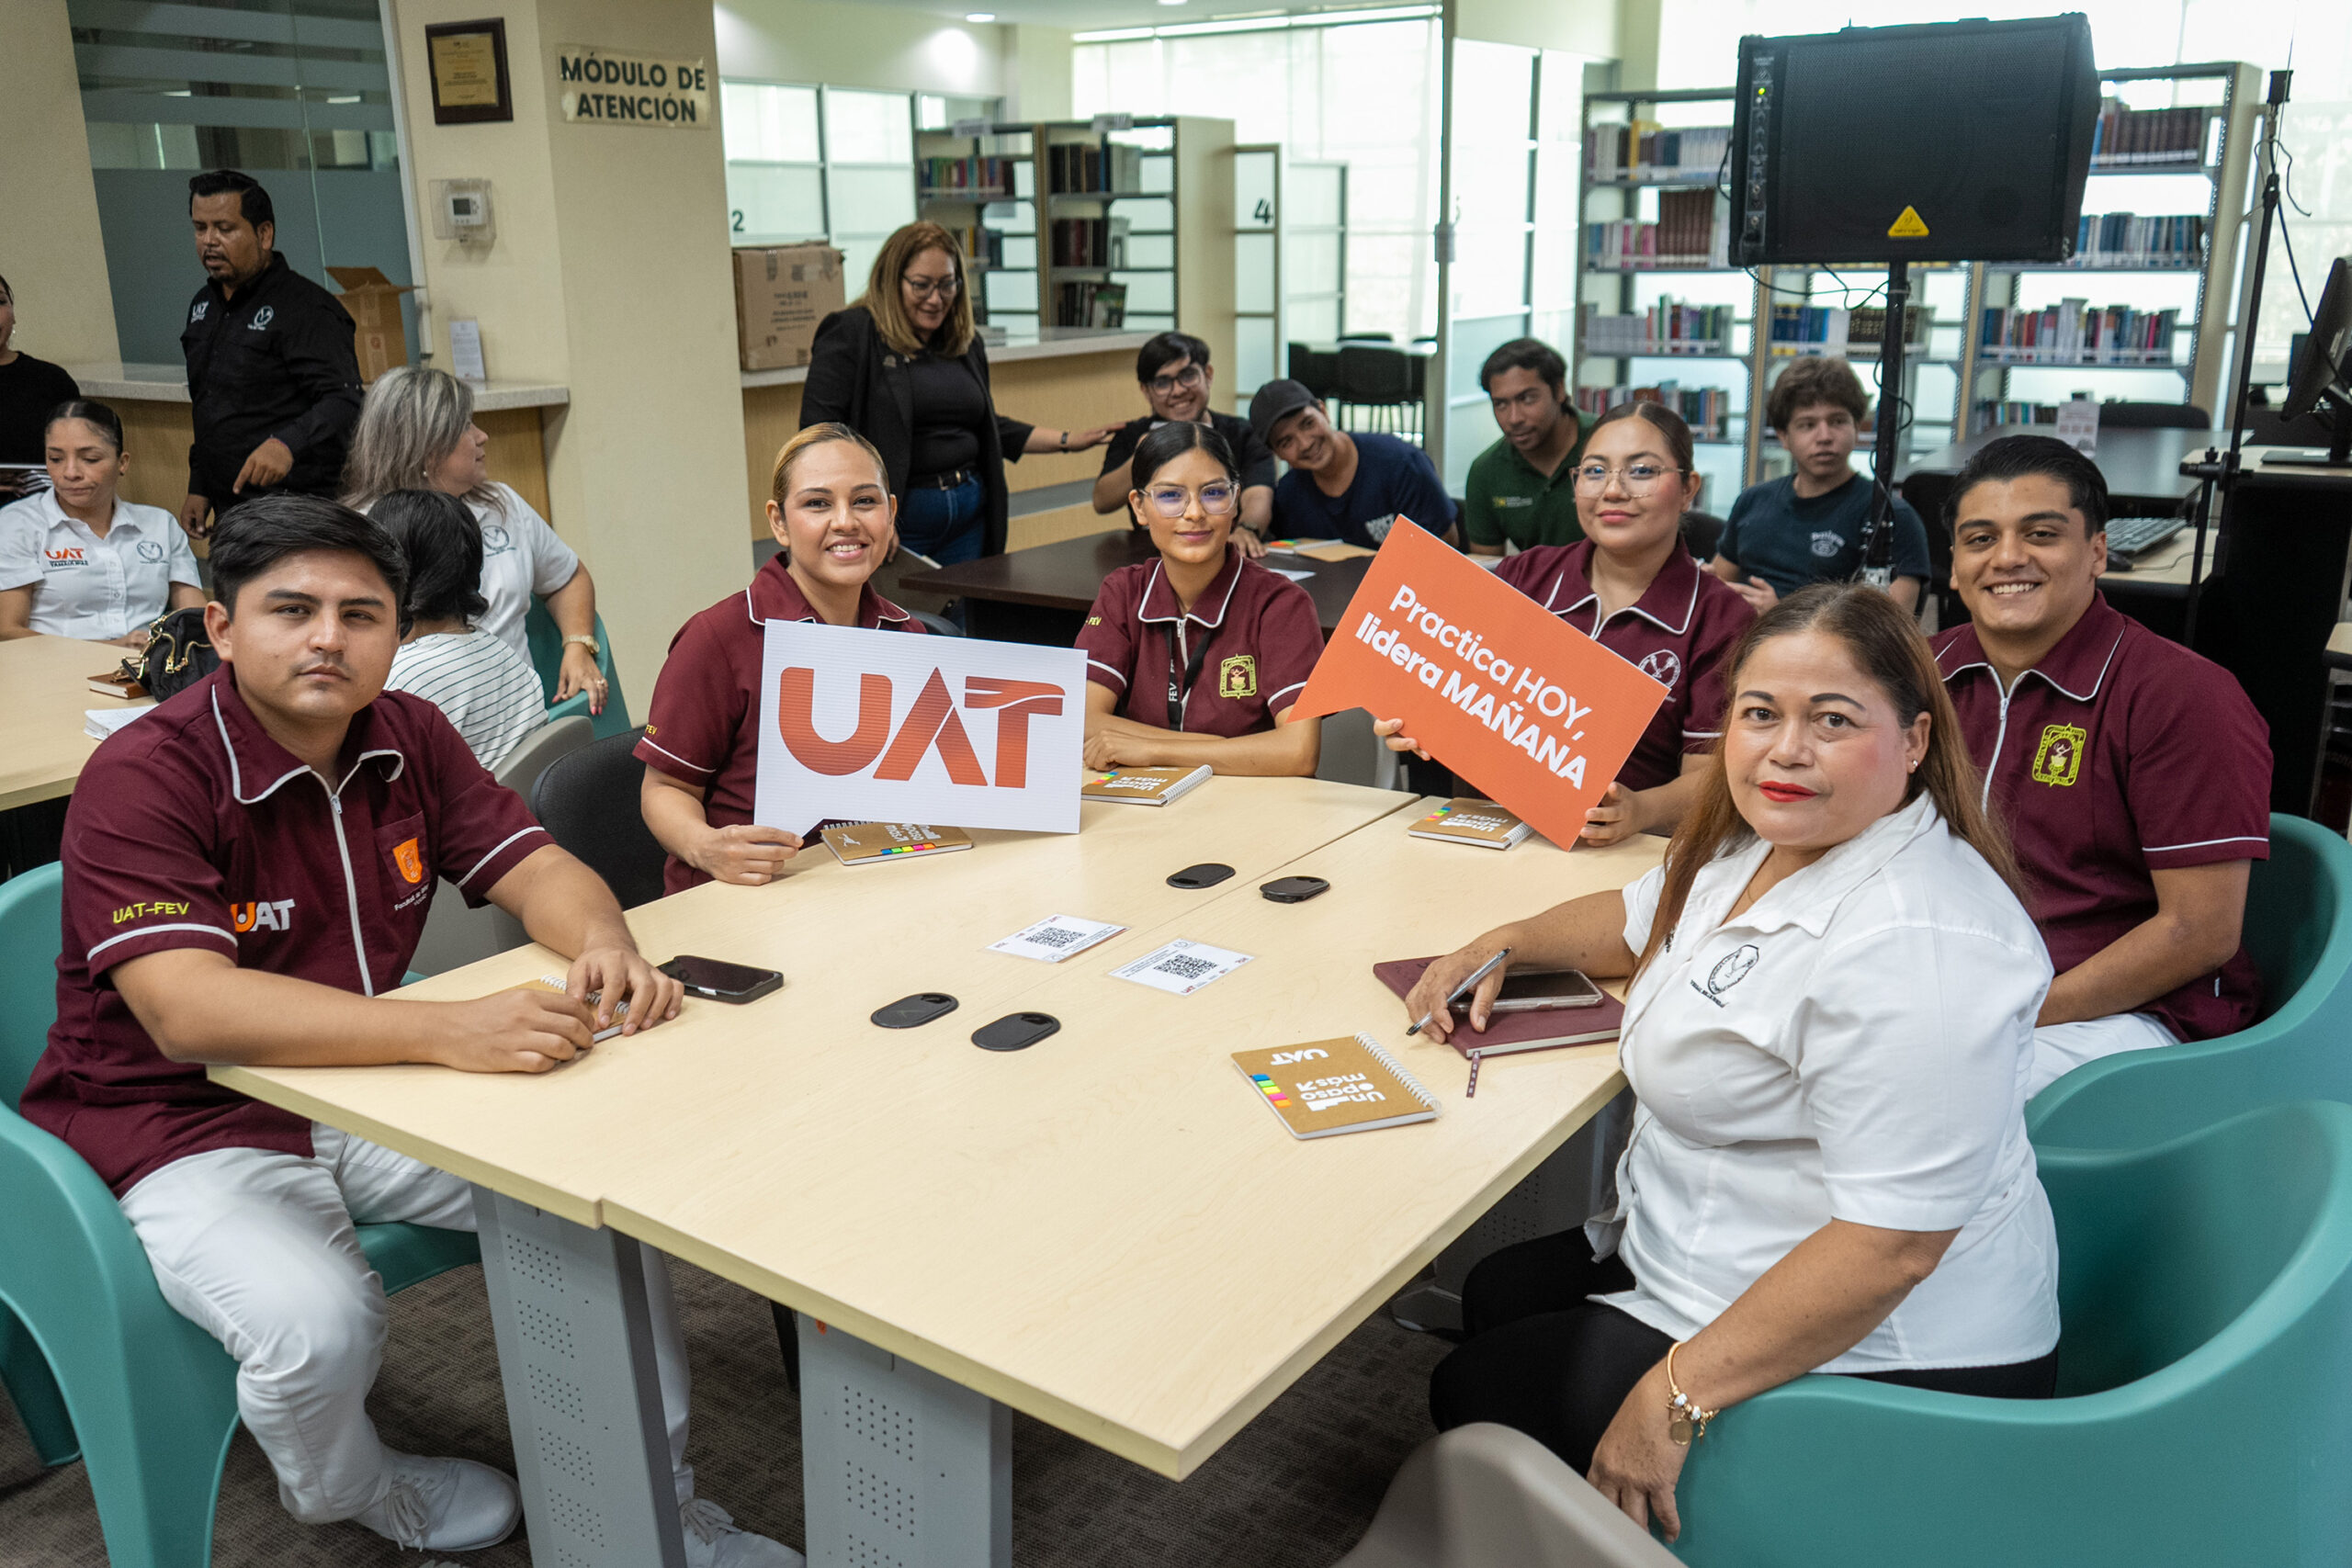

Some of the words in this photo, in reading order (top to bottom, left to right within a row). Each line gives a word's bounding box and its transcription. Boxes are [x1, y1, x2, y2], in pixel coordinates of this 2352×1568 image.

[560, 51, 667, 87] MÓDULO
[677, 66, 706, 91] DE
[576, 93, 696, 122] ATENCIÓN
[732, 210, 745, 231] 2
[1254, 198, 1273, 224] 4
[44, 547, 84, 559] UAT
[1388, 583, 1515, 685] Practica
[1511, 667, 1593, 741] HOY,
[1168, 682, 1178, 702] FEV
[1355, 612, 1444, 689] lidera
[1441, 670, 1588, 790] MAÑANA
[779, 667, 1066, 789] UAT
[113, 902, 190, 924] UAT-FEV
[231, 898, 296, 932] UAT
[1270, 1048, 1329, 1066] UAT
[1315, 1072, 1367, 1087] más
[1300, 1083, 1360, 1100] paso
[1349, 1090, 1386, 1102] Un
